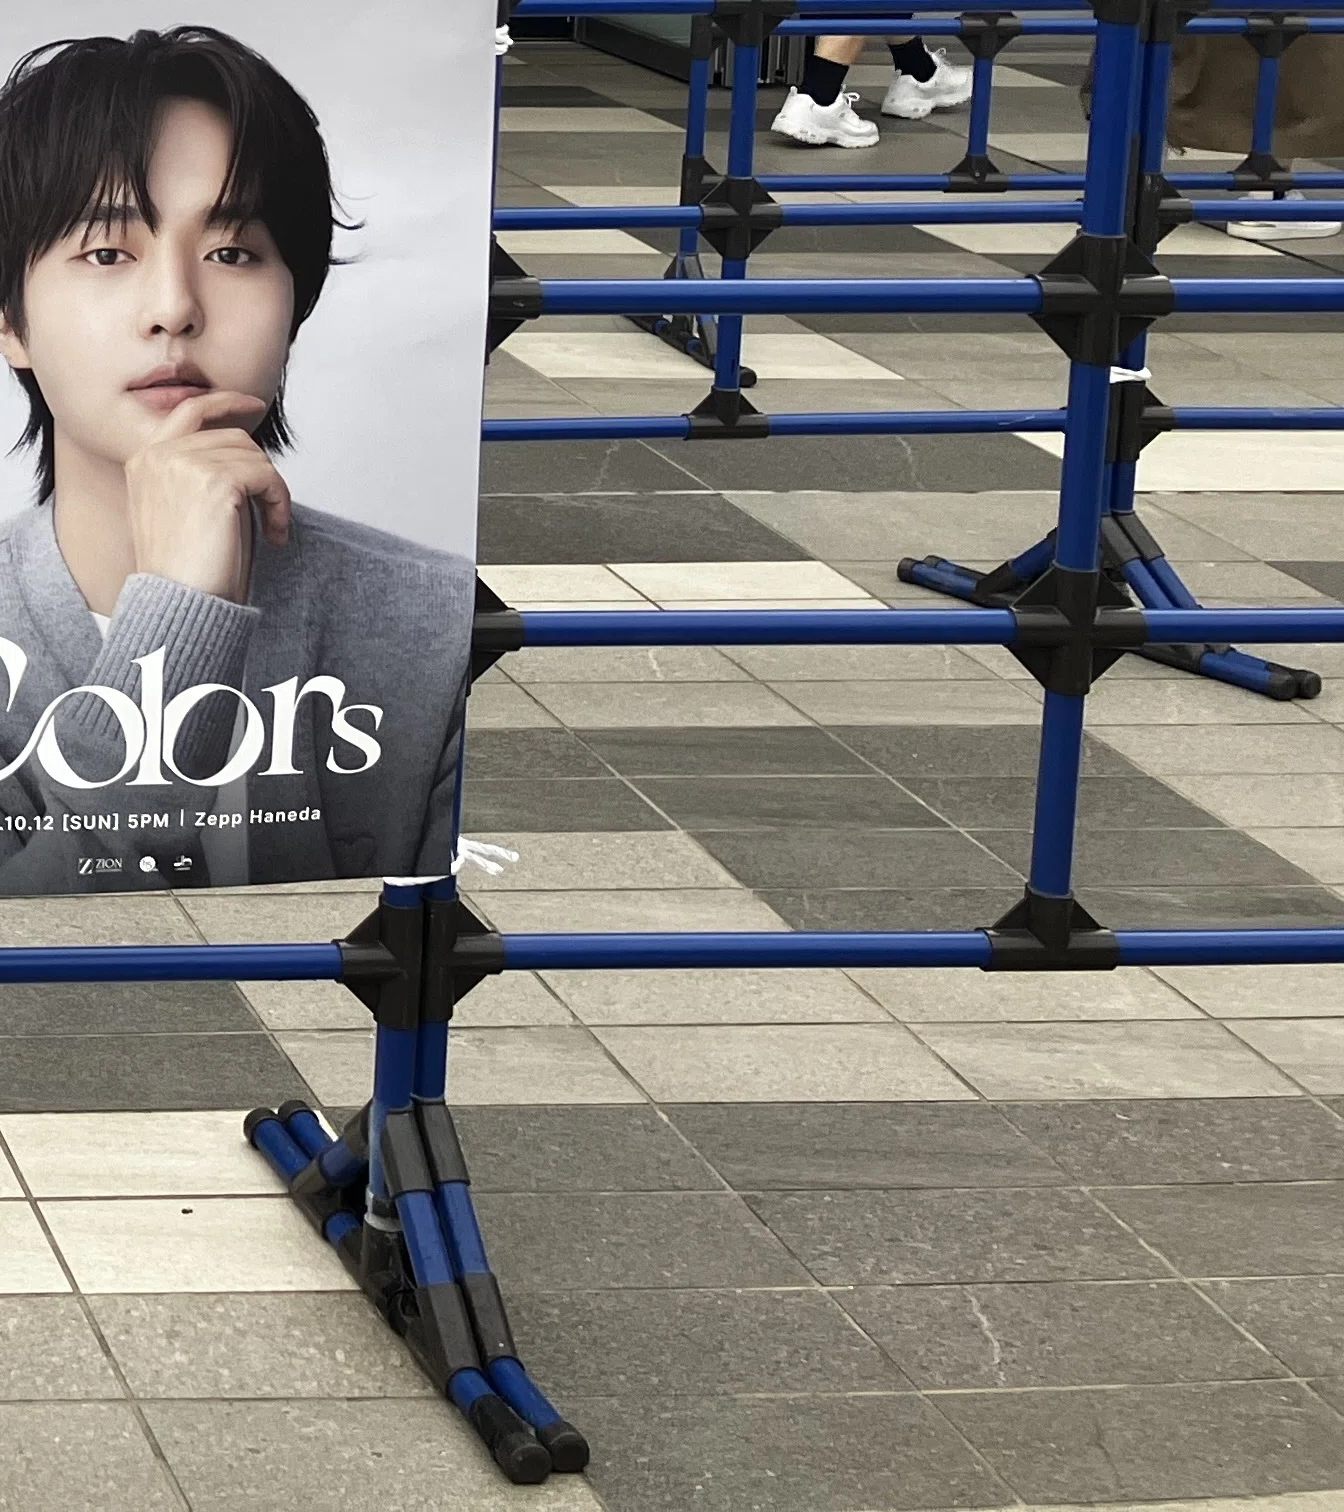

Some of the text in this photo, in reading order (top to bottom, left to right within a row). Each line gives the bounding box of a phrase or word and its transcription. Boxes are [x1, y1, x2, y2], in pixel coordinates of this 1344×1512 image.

[62, 812, 119, 832] [SUN]
[128, 813, 169, 829] 5PM
[195, 811, 243, 829] Zepp
[250, 806, 321, 824] Haneda
[95, 858, 123, 869] ZION
